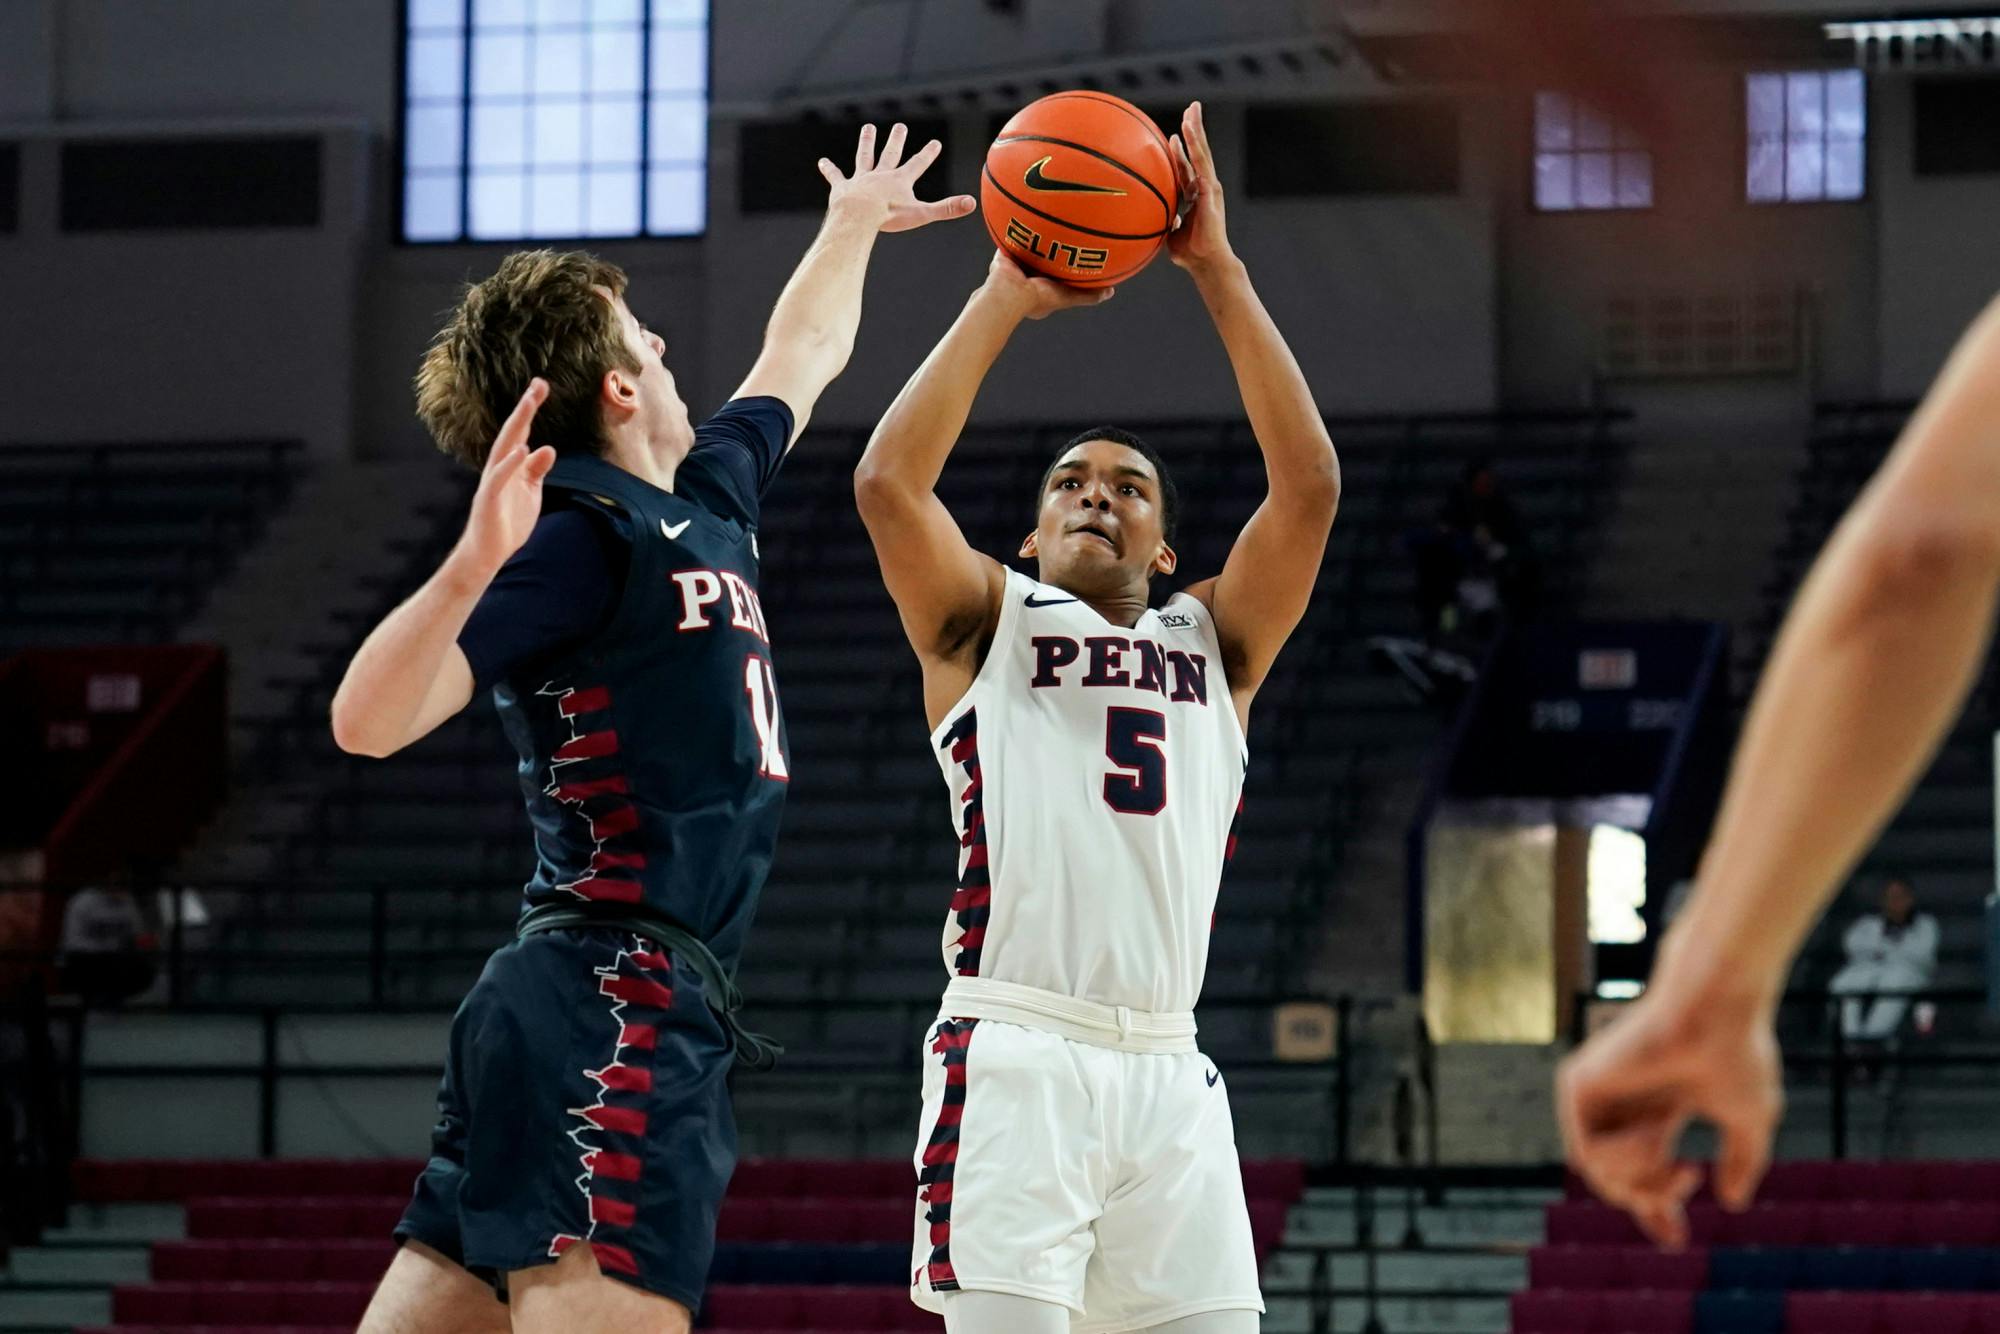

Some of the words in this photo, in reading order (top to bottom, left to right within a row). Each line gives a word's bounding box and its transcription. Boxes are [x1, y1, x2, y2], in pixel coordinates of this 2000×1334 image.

[1005, 216, 1109, 271] ELITE
[670, 567, 770, 644] PEN
[1031, 636, 1207, 706] PENN
[1103, 705, 1167, 816] 5
